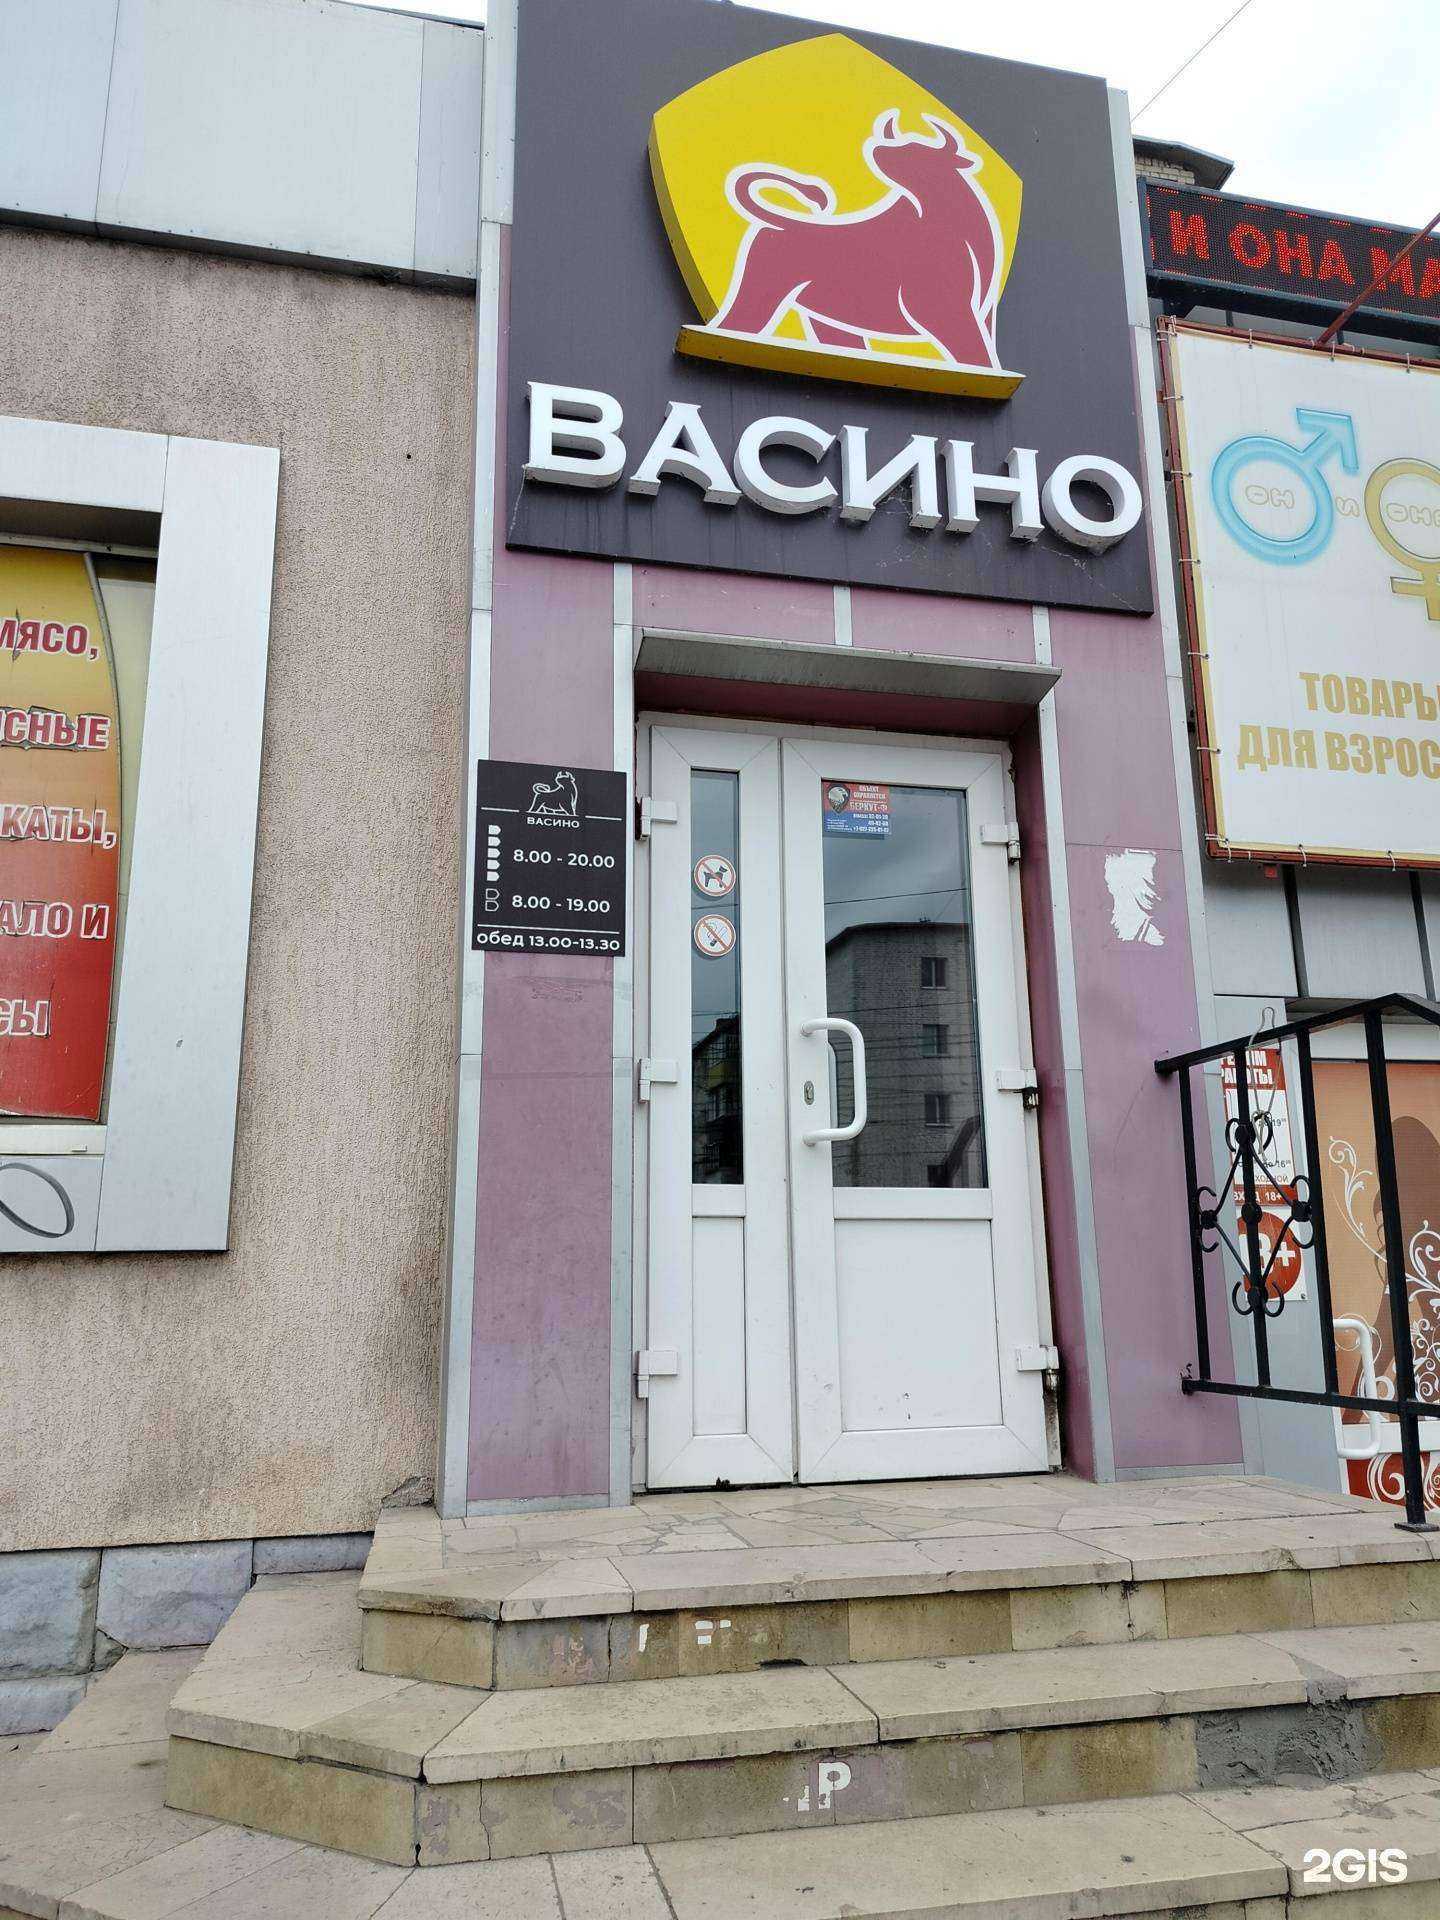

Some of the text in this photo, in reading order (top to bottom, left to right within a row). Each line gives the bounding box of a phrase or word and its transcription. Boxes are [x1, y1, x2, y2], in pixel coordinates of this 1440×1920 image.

[1168, 209, 1211, 260] И
[1228, 220, 1356, 287] ОНА
[525, 381, 1144, 554] ВАСИНО
[0, 709, 112, 749] СНЫЕ
[1237, 724, 1440, 780] ДЛЯ ВЗРОС
[527, 816, 580, 828] ВАСИНО
[513, 849, 552, 864] 8.00
[567, 853, 615, 868] 20.00
[80, 904, 110, 940] И
[512, 895, 550, 909] 8.00
[566, 898, 610, 913] 19.00
[477, 930, 620, 951] обед 13.00-13.30
